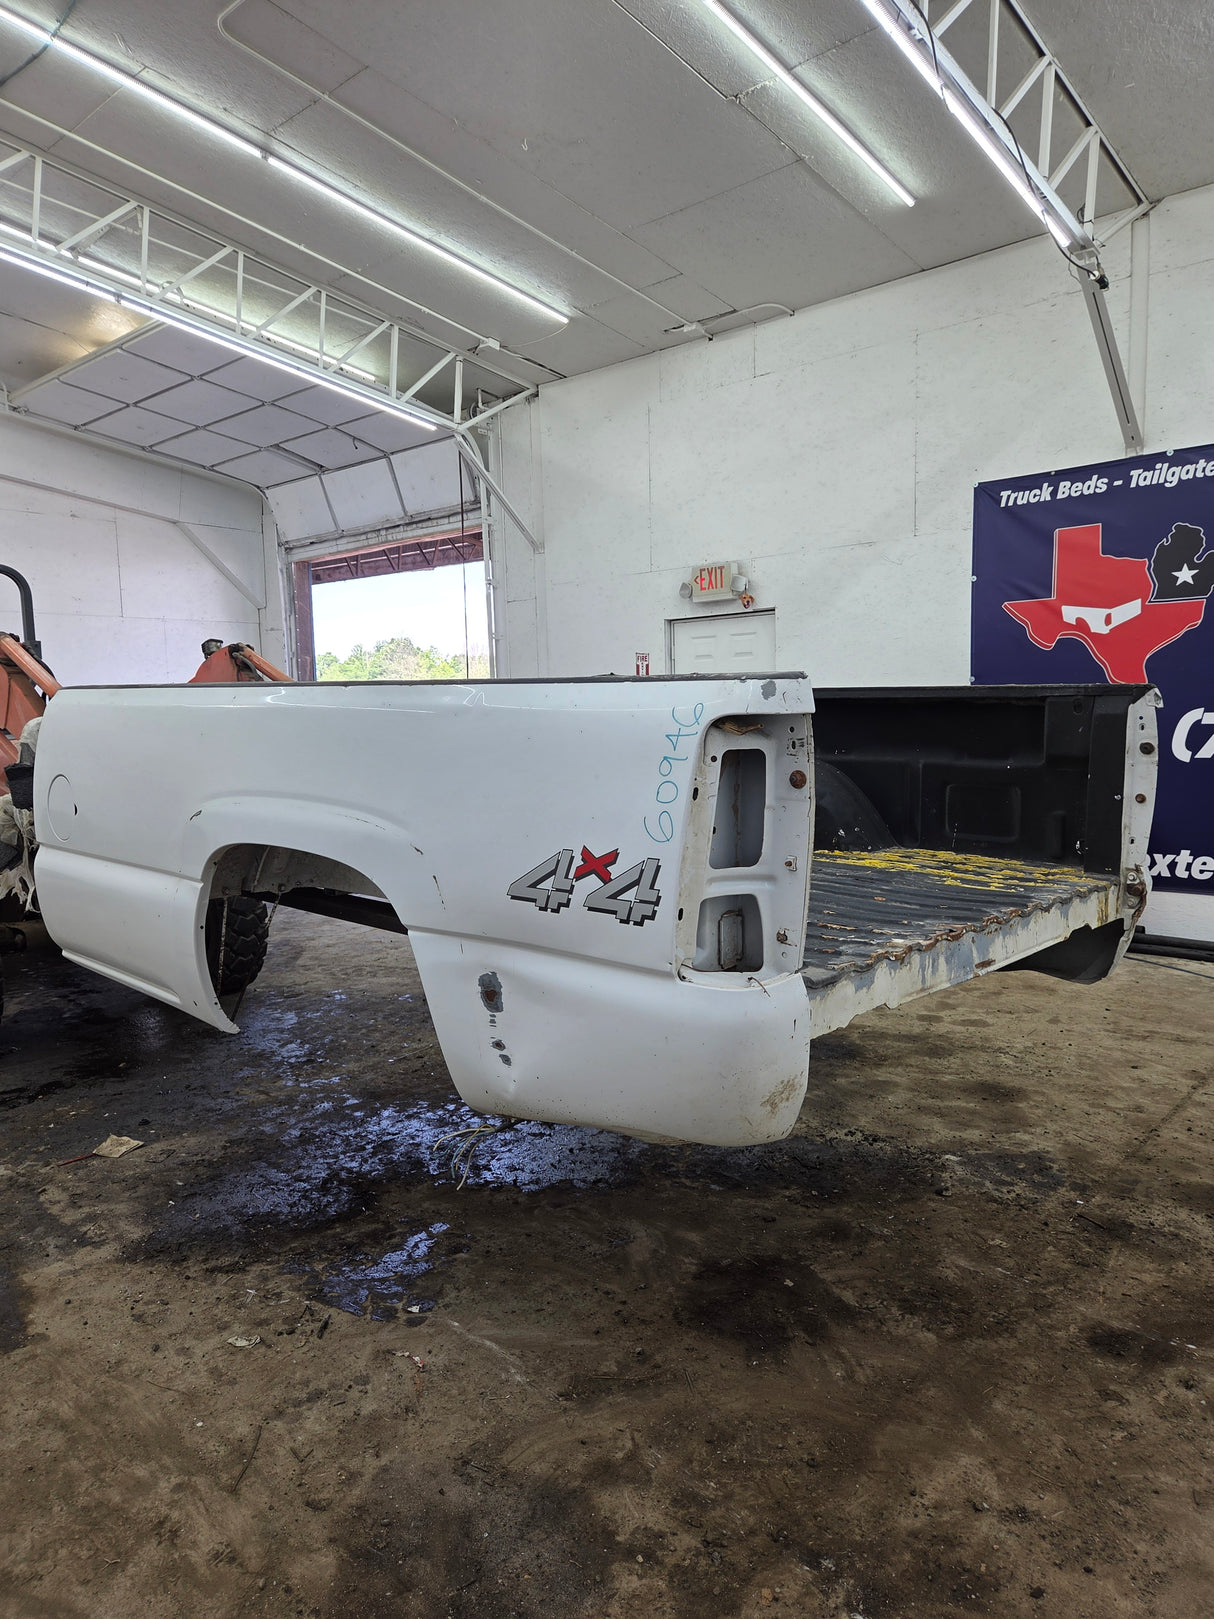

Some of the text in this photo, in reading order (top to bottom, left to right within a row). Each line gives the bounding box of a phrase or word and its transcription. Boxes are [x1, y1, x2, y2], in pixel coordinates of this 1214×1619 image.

[1000, 483, 1053, 508] Truck
[1056, 475, 1108, 499] Beds
[699, 566, 725, 591] EXIT
[636, 655, 648, 663] FIRE
[644, 702, 704, 843] 60946
[1145, 850, 1214, 880] xte
